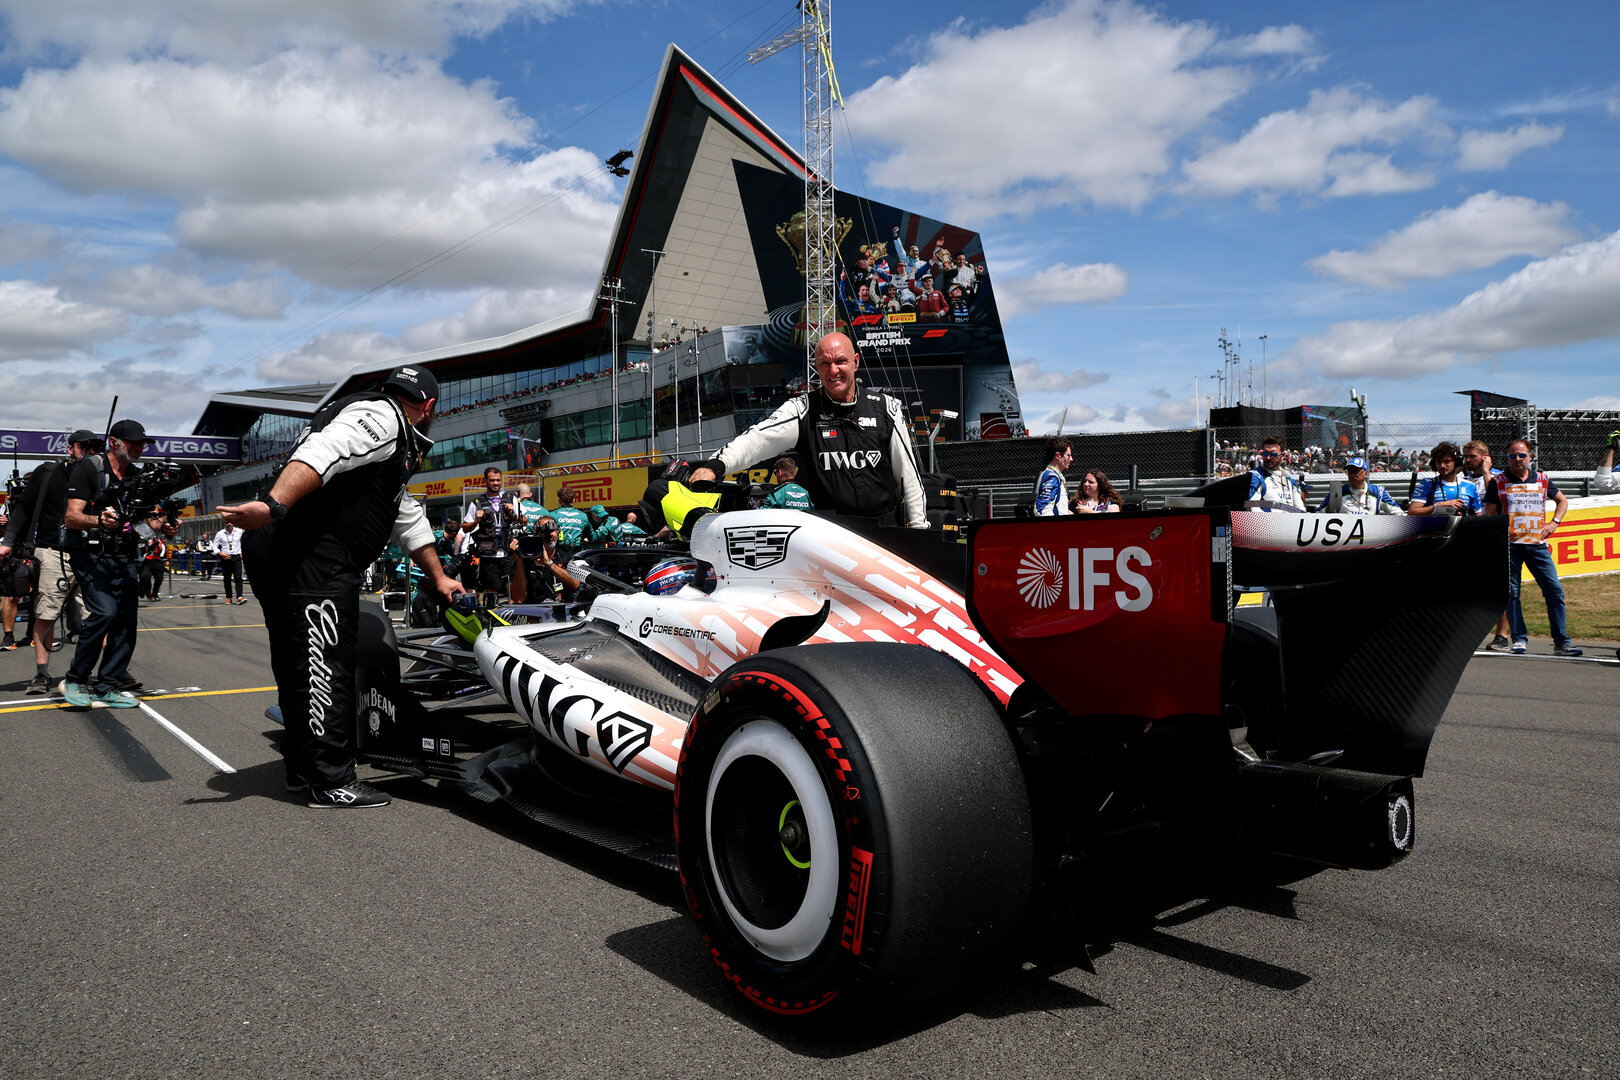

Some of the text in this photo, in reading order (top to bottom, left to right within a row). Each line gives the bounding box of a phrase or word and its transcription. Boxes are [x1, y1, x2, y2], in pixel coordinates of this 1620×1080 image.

[889, 314, 914, 322] PIRELLI
[857, 338, 911, 347] GRAND PRIX
[866, 331, 901, 340] BRITISH
[357, 419, 380, 442] PIRELLI
[858, 417, 877, 427] 3M
[155, 440, 229, 455] VEGAS
[819, 450, 868, 471] TWG
[425, 482, 447, 496] DHL
[786, 500, 809, 508] aramco
[1296, 518, 1365, 547] USA
[1068, 546, 1154, 612] IFS
[653, 624, 717, 641] CORE SCIENTIFIC
[305, 599, 338, 737] Cadillac
[357, 687, 396, 724] JIM BEAM
[493, 651, 605, 758] TWG
[840, 845, 874, 955] PIRELLI
